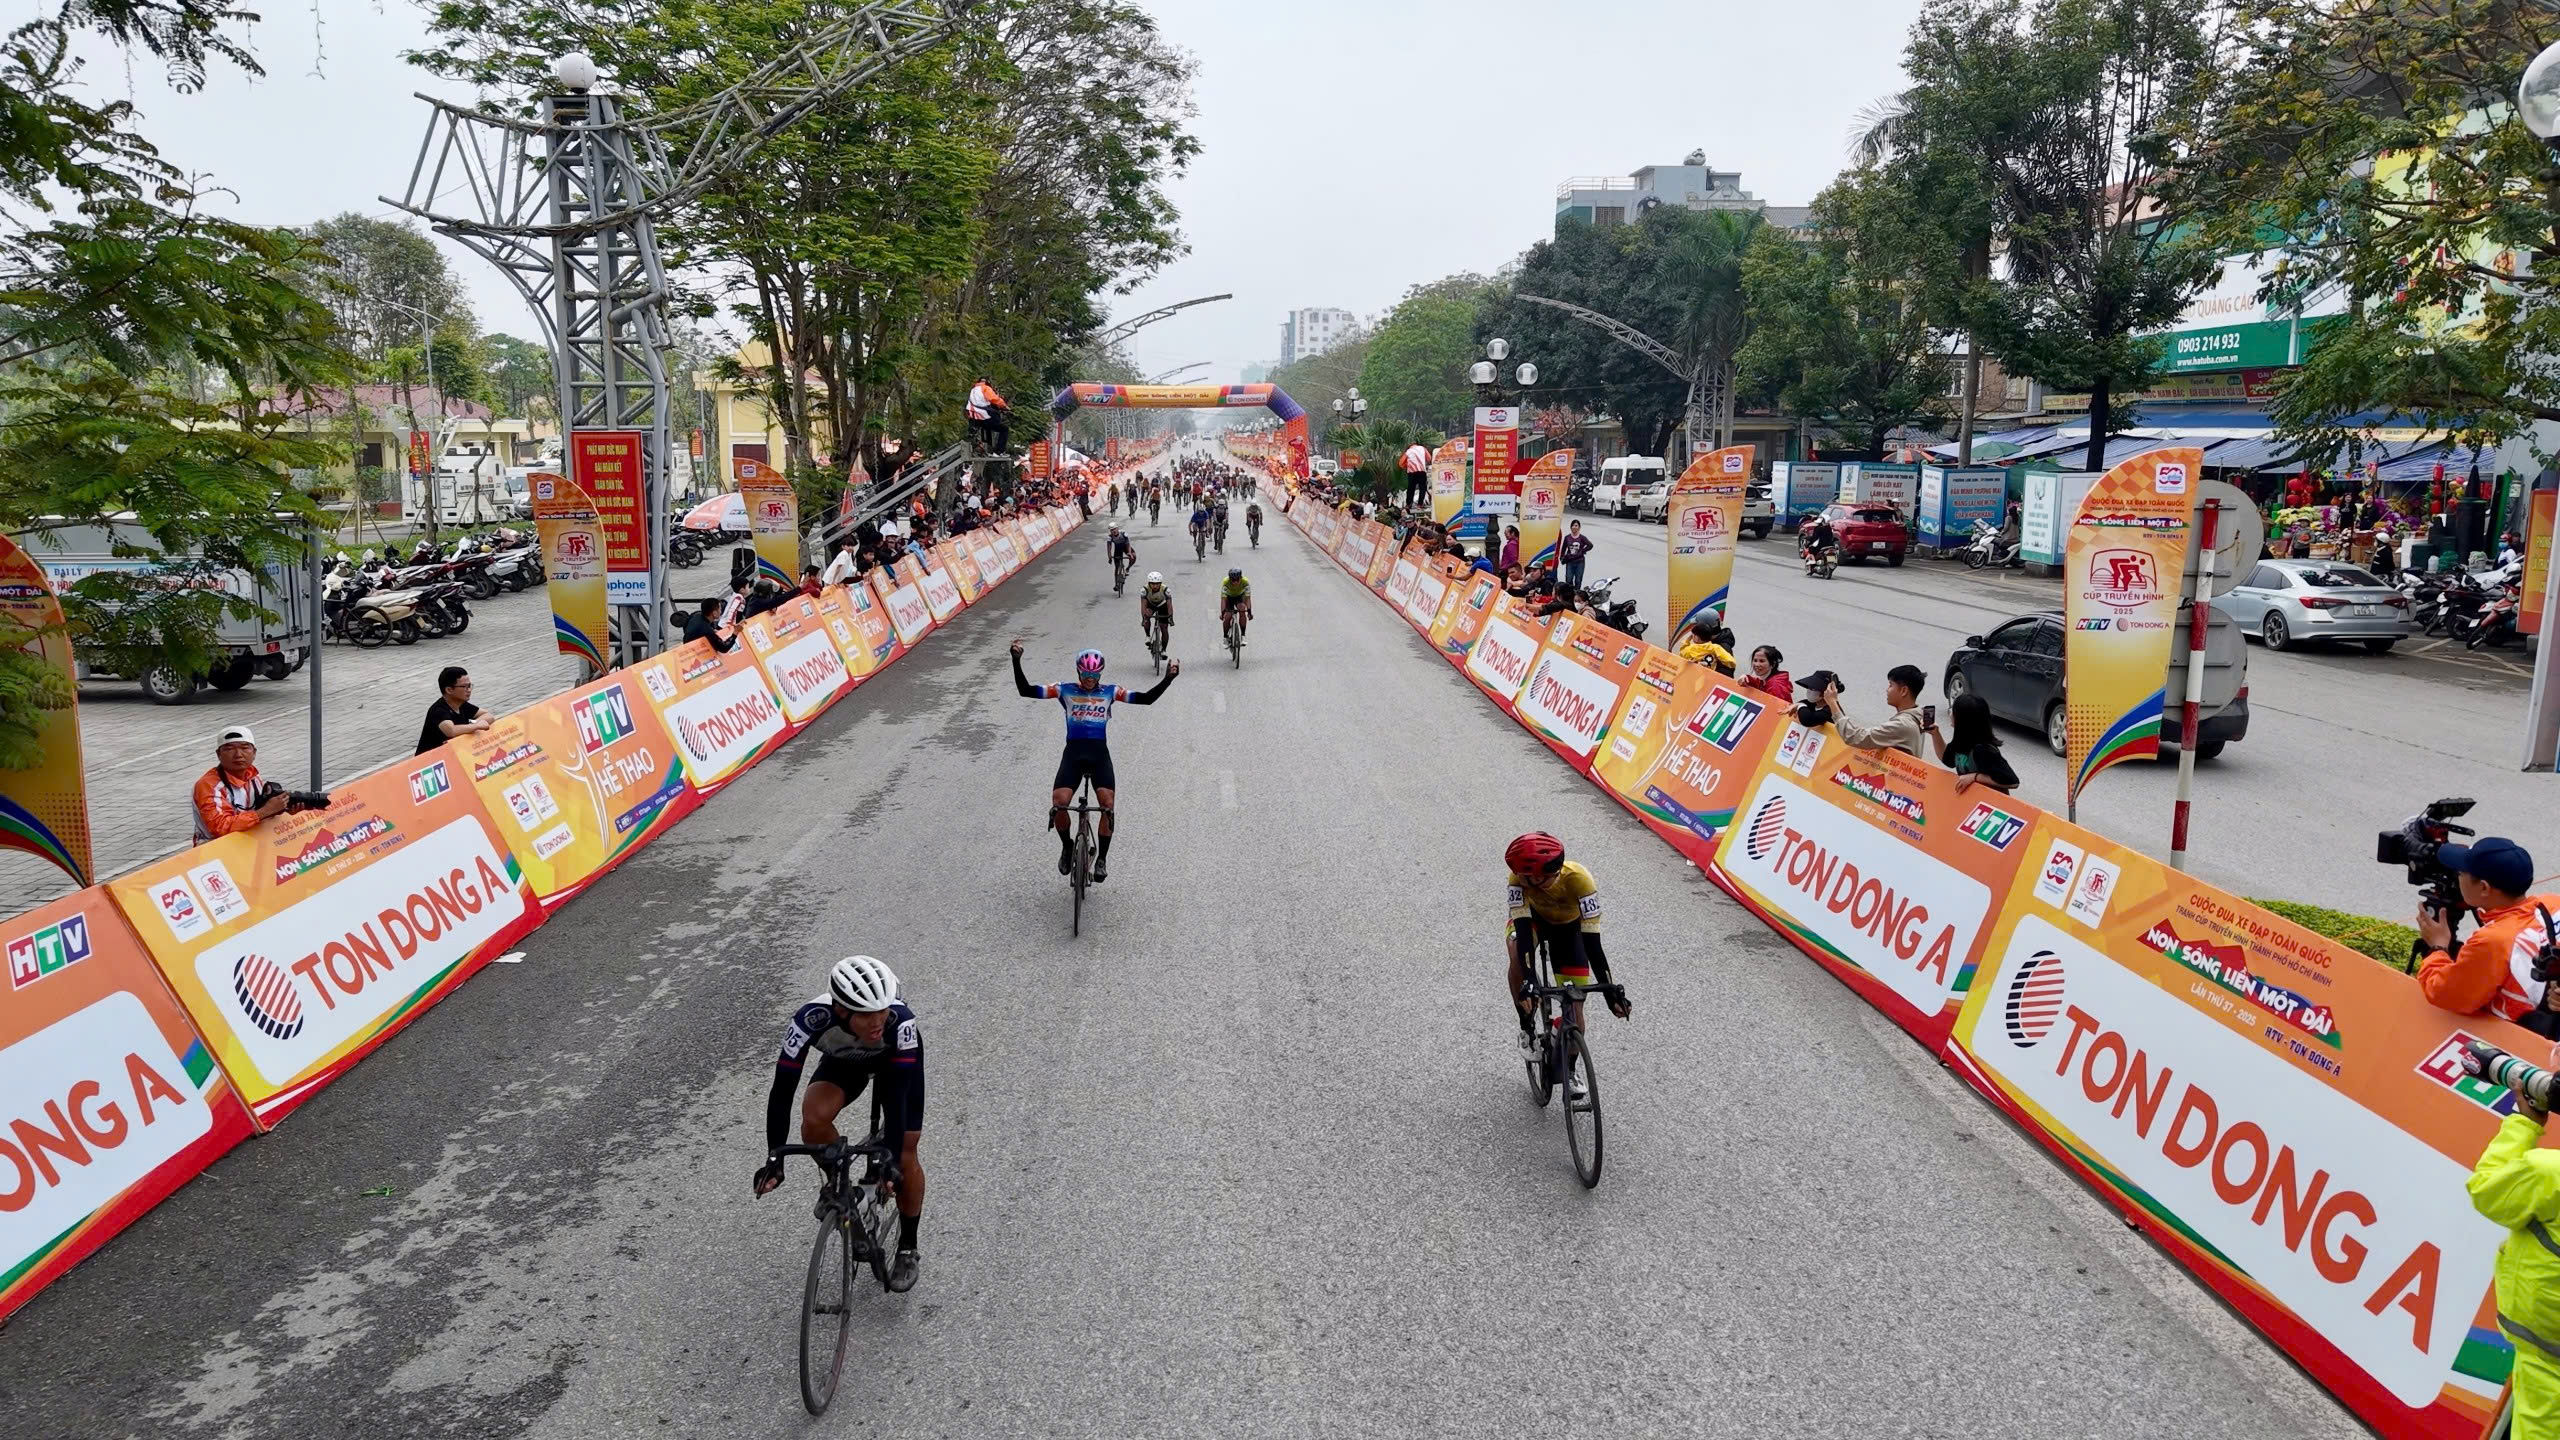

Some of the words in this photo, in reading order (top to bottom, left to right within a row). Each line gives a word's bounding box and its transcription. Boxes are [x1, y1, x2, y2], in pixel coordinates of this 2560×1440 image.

[2177, 337, 2201, 353] 0903
[2201, 335, 2220, 351] 214
[2221, 333, 2240, 349] 932
[2177, 354, 2239, 366] www.hatuba.com.vn
[2101, 517, 2125, 526] SÔNG
[2127, 517, 2145, 526] LIỀN
[2147, 518, 2166, 527] MỘT
[2083, 590, 2102, 600] CÚP
[2105, 589, 2140, 600] TRUYỀN
[2143, 591, 2164, 600] HÌNH
[2113, 607, 2134, 615] 2025
[2076, 619, 2111, 630] HTV
[2130, 621, 2144, 629] TON
[788, 661, 817, 696] TON
[805, 650, 835, 685] DONG
[1483, 639, 1502, 666] TON
[1493, 647, 1522, 683] DONG
[576, 692, 628, 746] HTV
[698, 711, 738, 753] TON
[724, 692, 768, 738] DONG
[760, 689, 778, 718] A
[1071, 704, 1106, 714] PELIO
[1071, 711, 1105, 719] KENDA
[1539, 676, 1566, 714] TON
[1556, 688, 1595, 734] DONG
[1584, 708, 1604, 741] A
[1694, 694, 1756, 743] HTV
[410, 765, 447, 799] HTV
[615, 746, 656, 787] THAO
[1680, 753, 1722, 797] THAO
[1834, 770, 1851, 786] NON
[1851, 776, 1874, 800] SÔNG
[1887, 794, 1908, 814] MỘT
[1907, 801, 1924, 820] DẢI
[276, 860, 302, 880] NON
[302, 842, 332, 868] SÔNG
[331, 832, 351, 854] LIỀN
[349, 825, 370, 846] MỘT
[370, 817, 388, 836] DẢI
[1959, 804, 2023, 850] HTV
[1582, 898, 1600, 914] 13
[1773, 826, 1840, 900] TON
[1827, 861, 1929, 961] DONG
[1914, 922, 1957, 987] A
[9, 914, 91, 987] HTV
[291, 922, 397, 1012] TON
[376, 867, 483, 963] DONG
[473, 854, 510, 904] A
[2175, 904, 2196, 921] TRANH
[2194, 913, 2209, 926] CÚP
[2208, 919, 2234, 938] TRUYỀN
[2231, 930, 2250, 947] HÌNH
[2249, 939, 2272, 959] THÀNH
[2270, 949, 2288, 966] PHỐ
[2287, 957, 2300, 972] HỒ
[2297, 963, 2313, 978] CHÍ
[2311, 971, 2333, 988] MINH
[2189, 893, 2215, 915] CUỘC
[2215, 906, 2235, 925] ĐUA
[2235, 914, 2251, 931] XE
[2249, 919, 2270, 941] ĐẠP
[2269, 930, 2299, 953] TOÀN
[2298, 944, 2332, 969] QUỐC
[2145, 926, 2181, 956] NON
[2180, 943, 2223, 981] SÔNG
[2222, 964, 2257, 997] LIỀN
[2257, 984, 2299, 1021] MỘT
[2300, 1005, 2334, 1037] DẢI
[2190, 981, 2208, 999] LẦN
[2205, 989, 2223, 1008] THỨ
[2221, 999, 2233, 1014] 37
[2236, 1008, 2258, 1027] 2025
[2264, 1025, 2284, 1046] HTV
[2289, 1036, 2309, 1058] TÔN
[0, 1078, 129, 1213] ONG
[124, 1051, 187, 1127] A
[2055, 1003, 2174, 1141] TON
[2161, 1082, 2379, 1285] DONG
[2363, 1239, 2442, 1356] A
